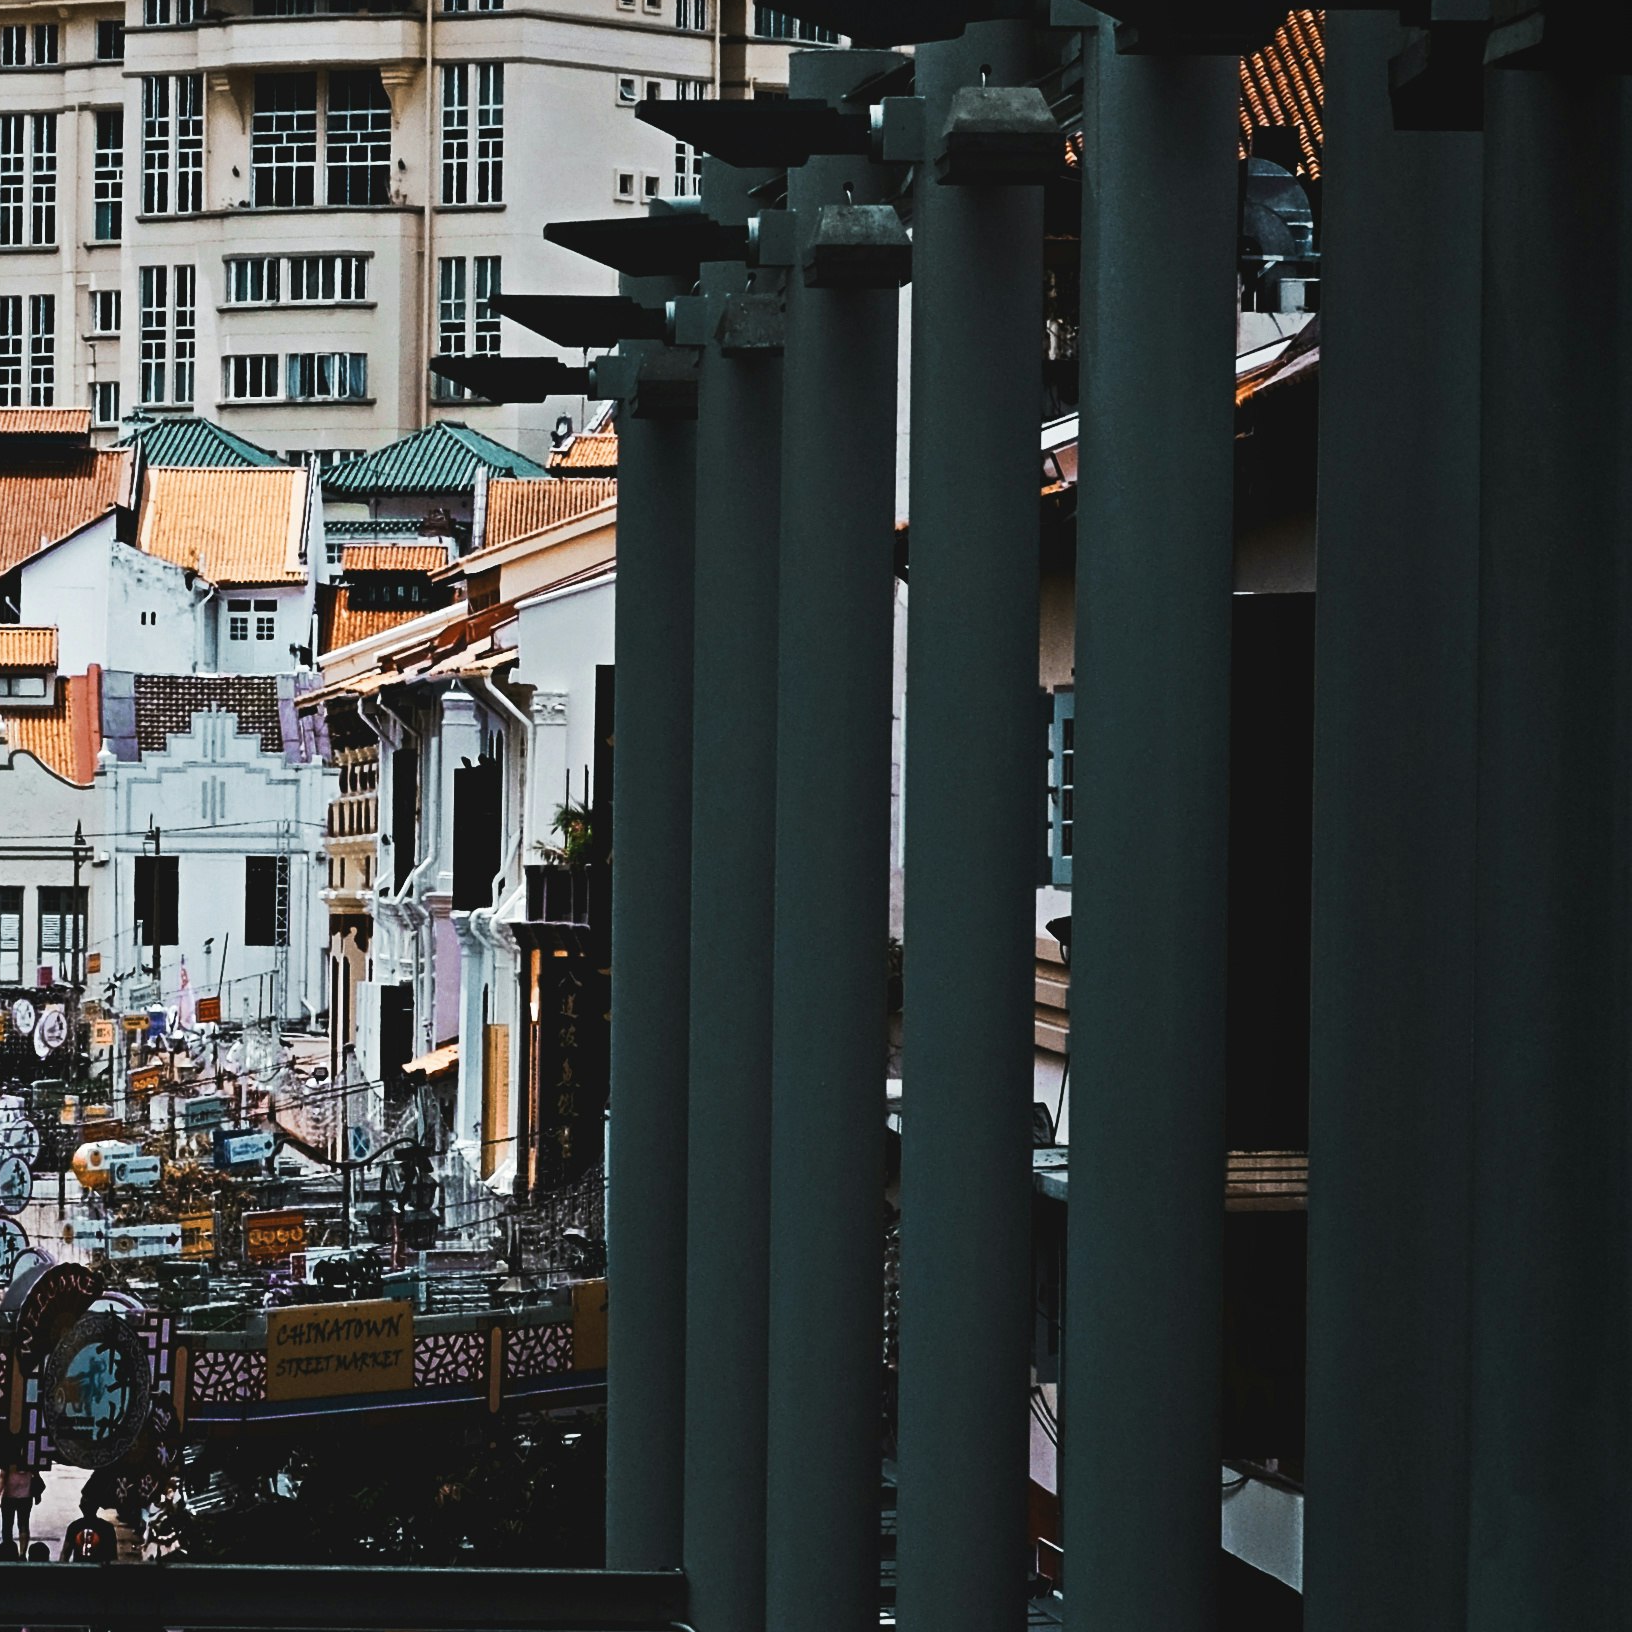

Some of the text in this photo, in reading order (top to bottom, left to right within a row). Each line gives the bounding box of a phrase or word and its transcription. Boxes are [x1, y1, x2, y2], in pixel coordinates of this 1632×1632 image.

[276, 1313, 404, 1346] CHINATOWN
[275, 1349, 404, 1378] STREET MARKET
